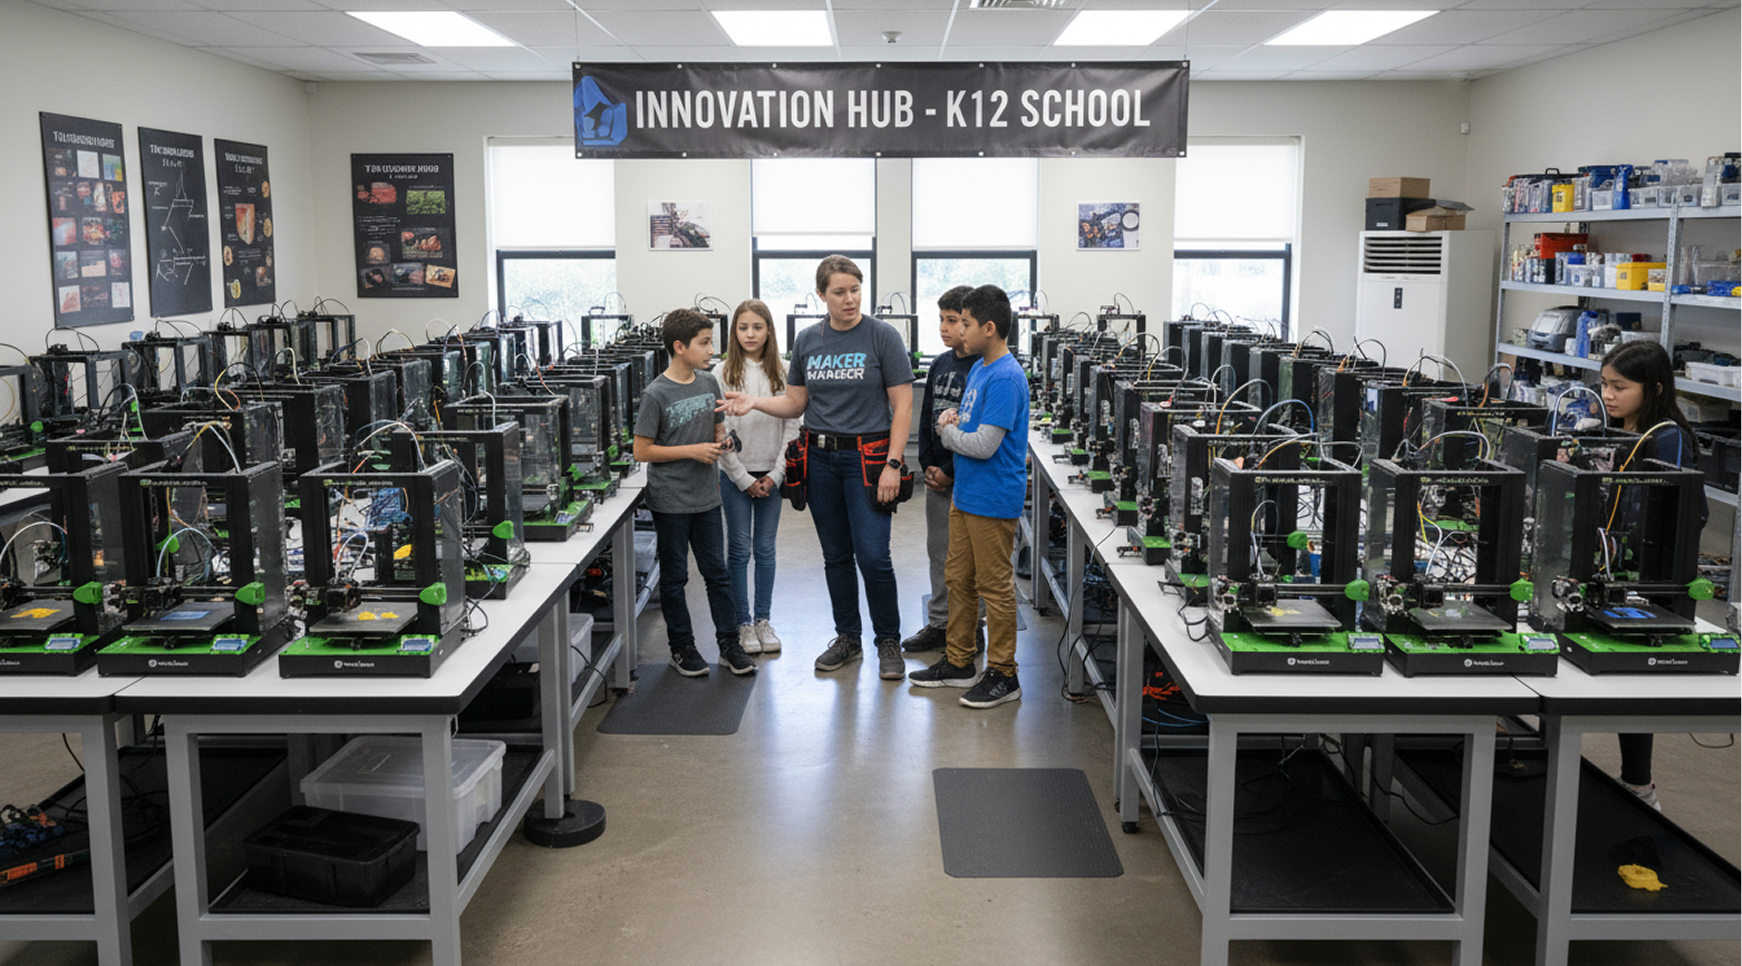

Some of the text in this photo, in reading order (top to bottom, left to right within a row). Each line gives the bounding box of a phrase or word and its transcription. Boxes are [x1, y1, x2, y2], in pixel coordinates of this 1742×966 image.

[636, 90, 834, 129] INNOVATION
[847, 90, 914, 129] HUB
[947, 90, 1009, 128] K12
[1020, 88, 1151, 128] SCHOOL
[806, 352, 867, 370] MAKER
